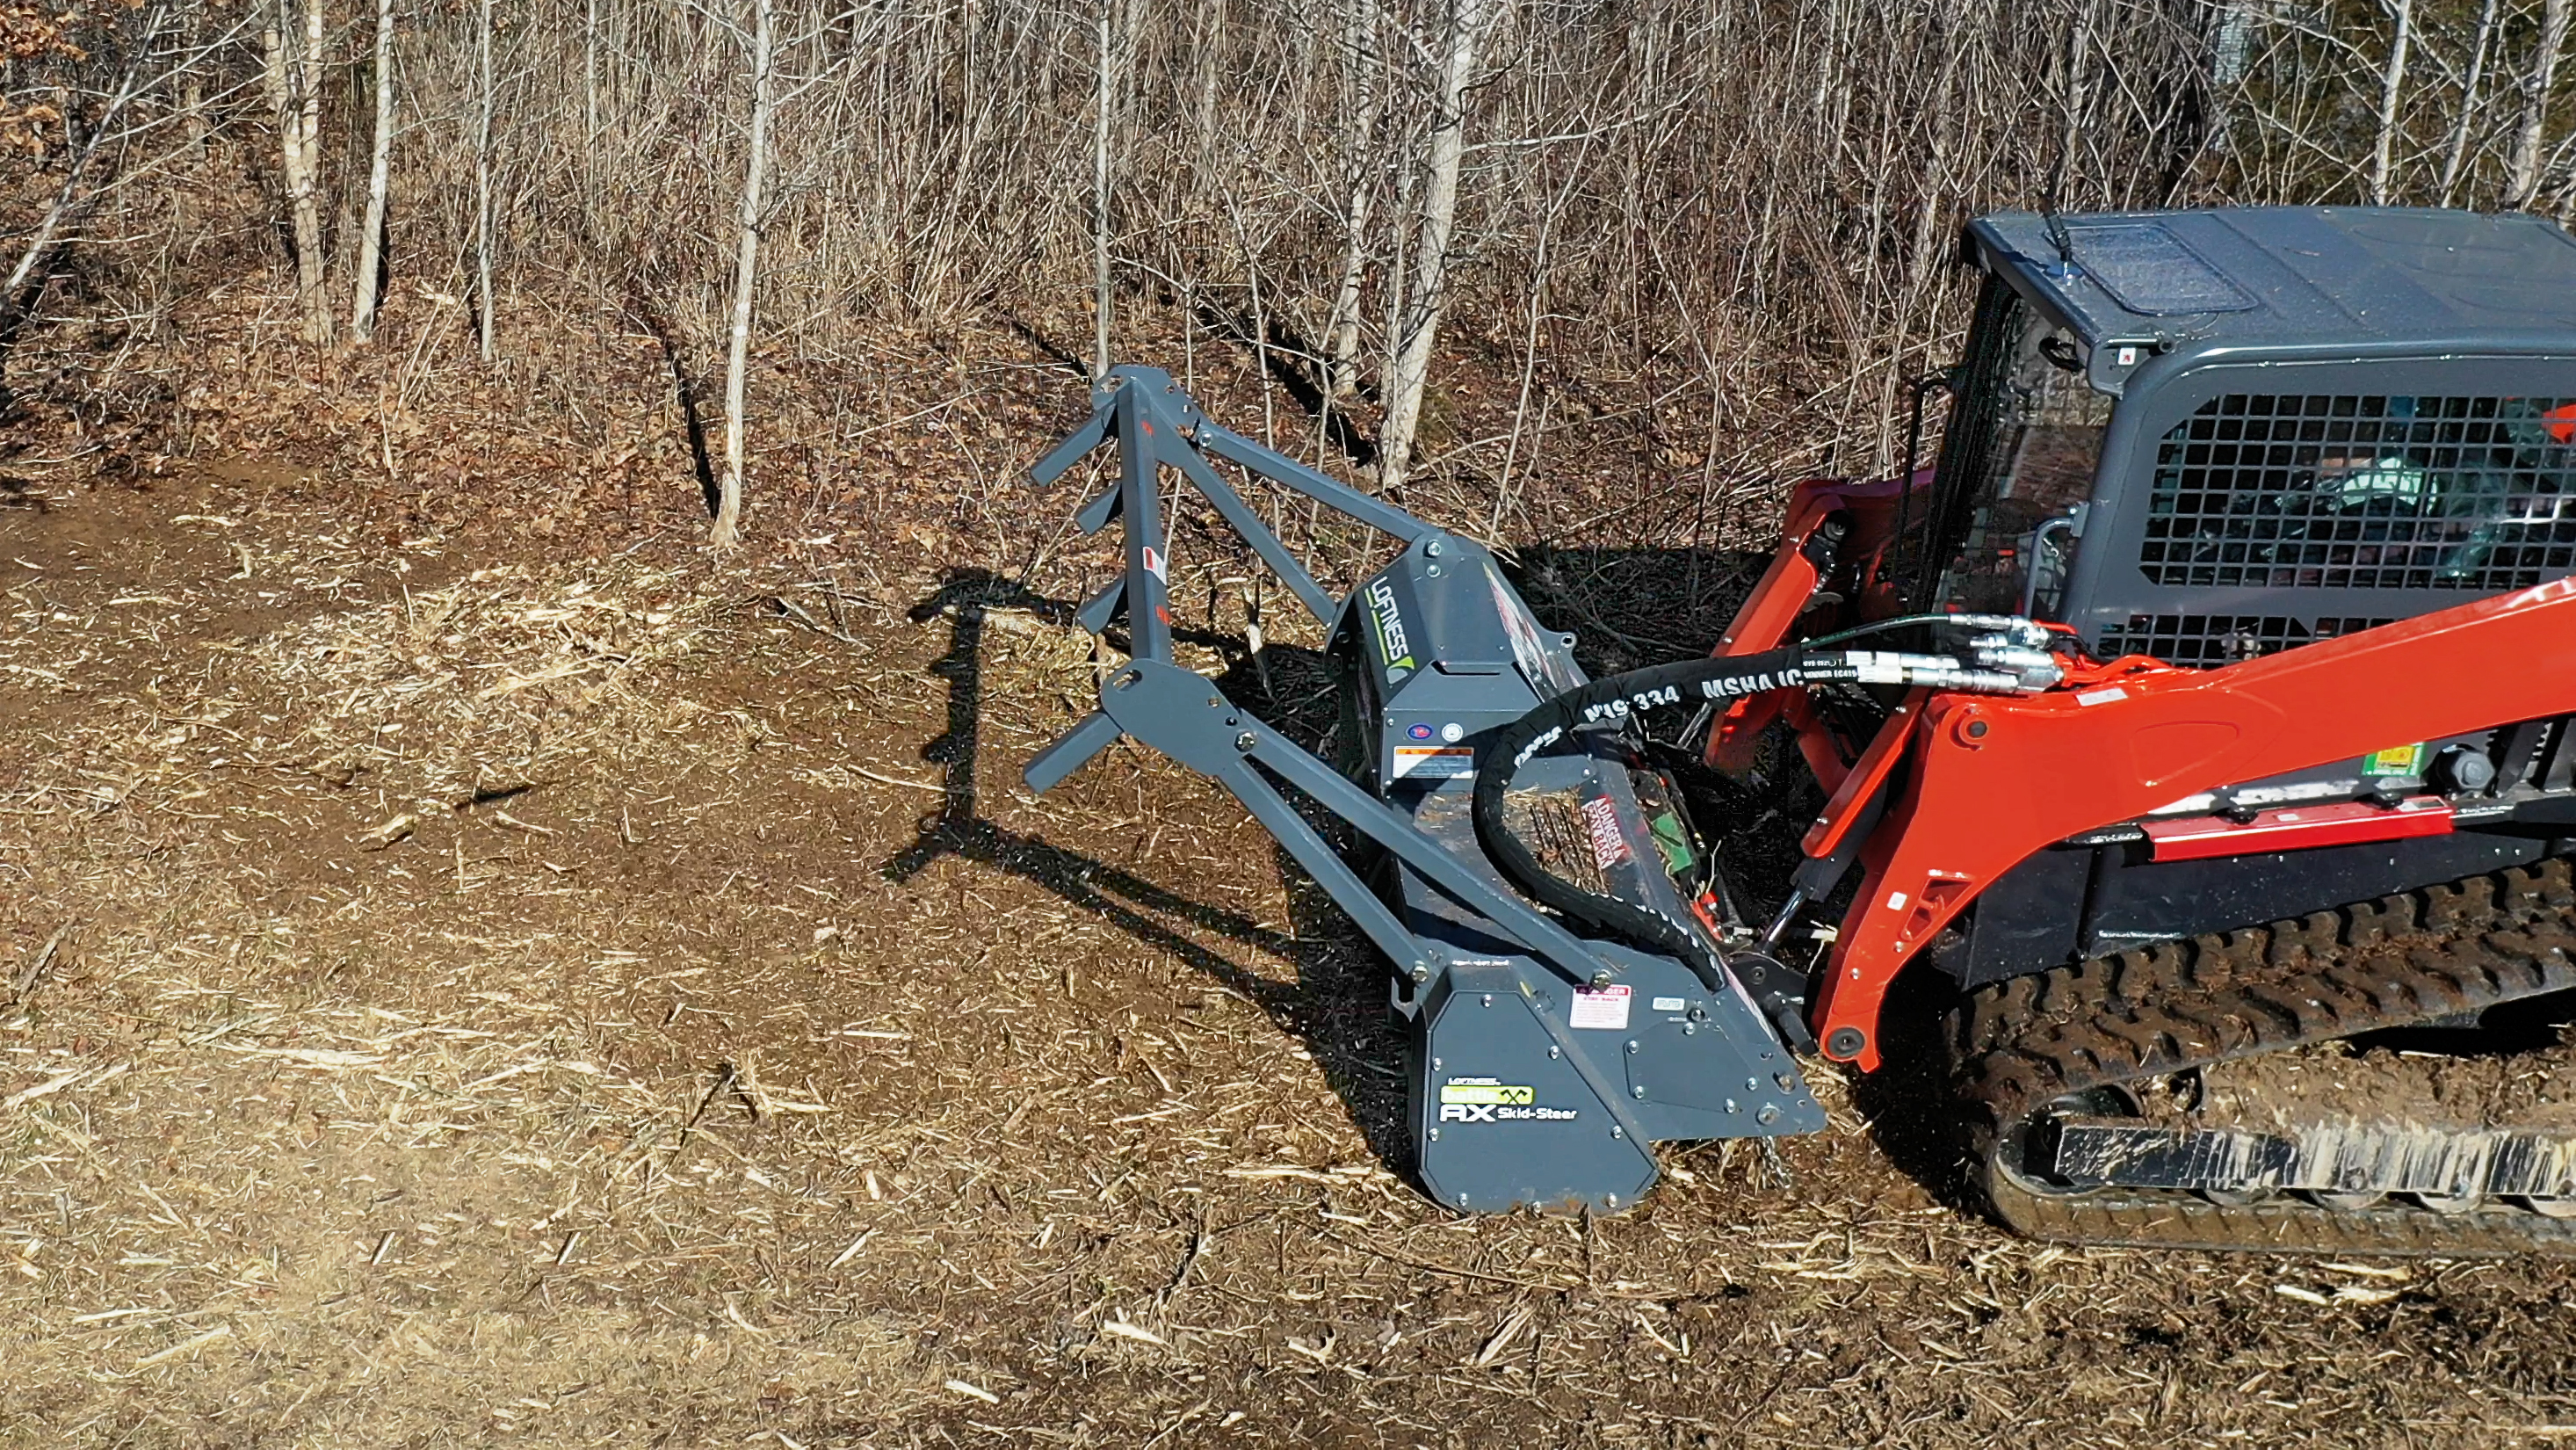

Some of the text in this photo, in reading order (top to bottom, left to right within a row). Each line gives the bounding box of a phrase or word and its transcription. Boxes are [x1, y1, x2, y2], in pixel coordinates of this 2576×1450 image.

[1371, 576, 1409, 661] LOFTNESS
[1702, 673, 1776, 698] MSHA
[1598, 803, 1623, 851] DANGER
[1594, 833, 1613, 866] BACK
[1440, 1104, 1577, 1122] AX Skid-Steer
